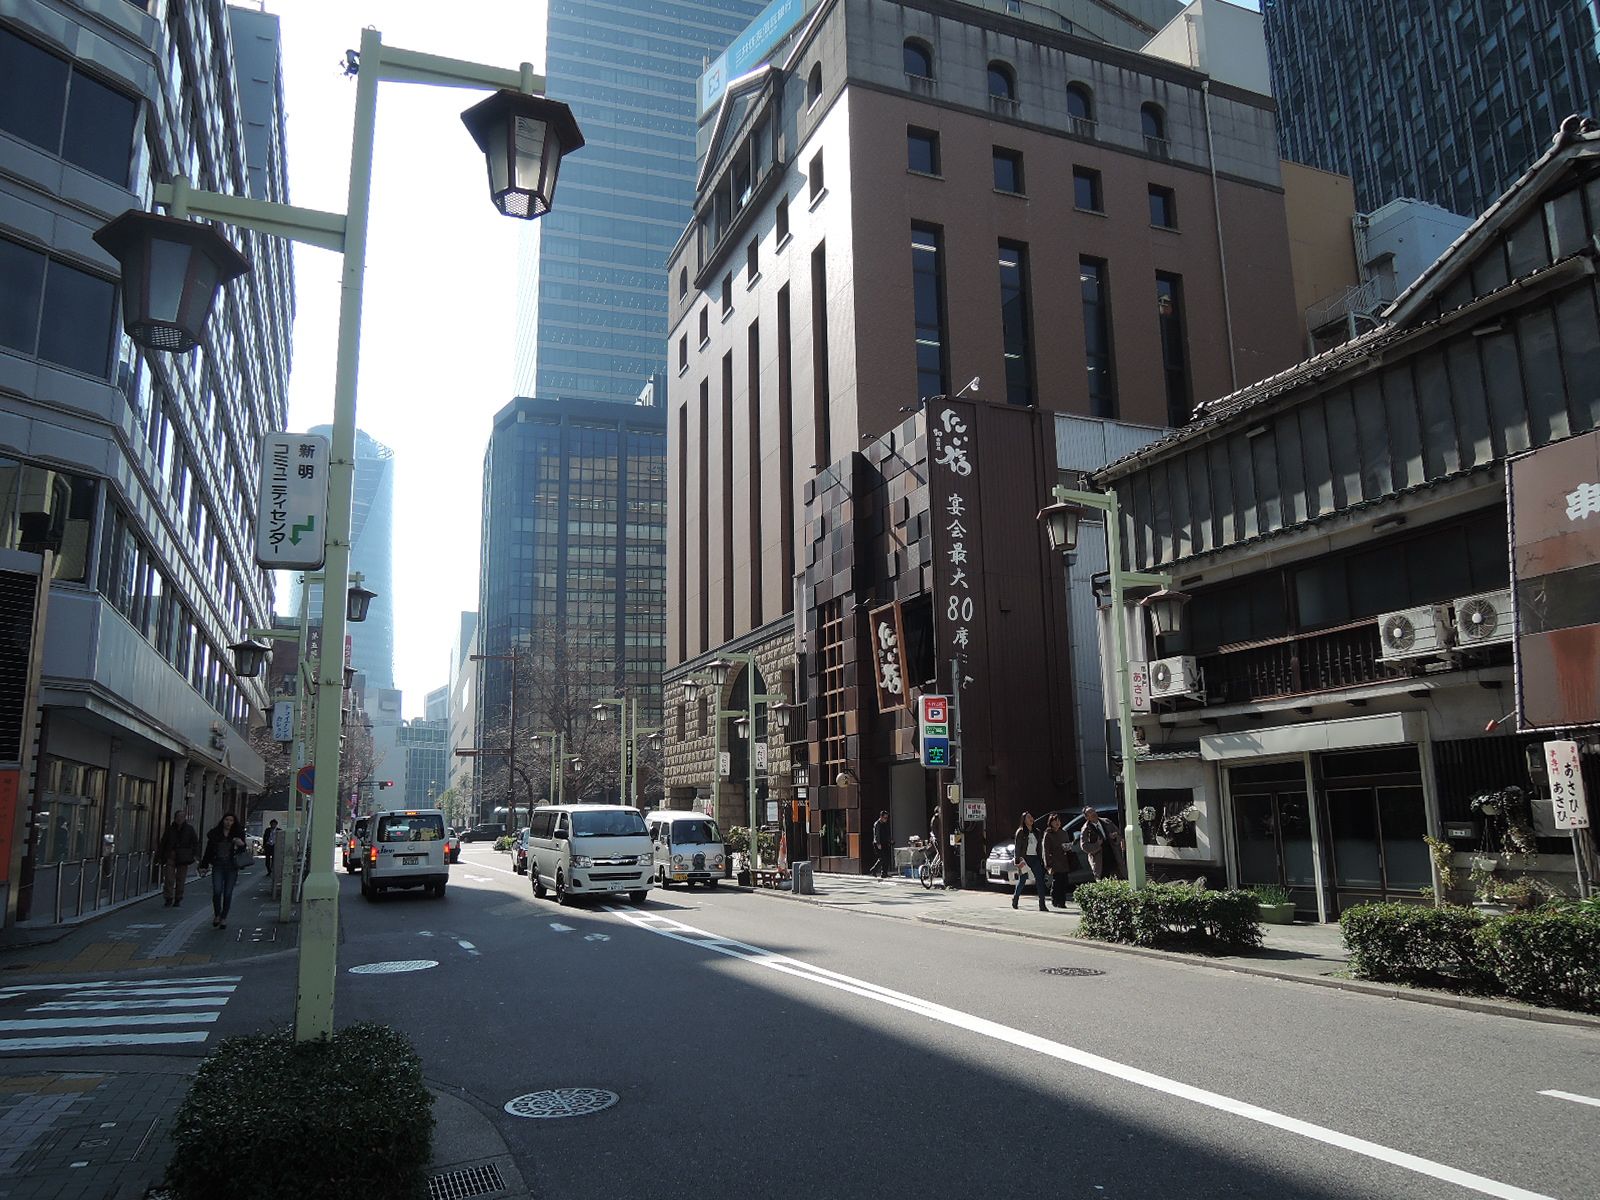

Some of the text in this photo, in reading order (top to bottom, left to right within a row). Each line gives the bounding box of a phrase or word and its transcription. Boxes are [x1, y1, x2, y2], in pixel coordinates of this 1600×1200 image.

[298, 443, 316, 479] 新明
[268, 444, 289, 554] コミュニティセンター
[1133, 672, 1143, 707] あさひ
[930, 709, 941, 719] P
[928, 746, 944, 763] 空
[1553, 781, 1568, 822] あさひ
[1564, 762, 1579, 813] あさひ
